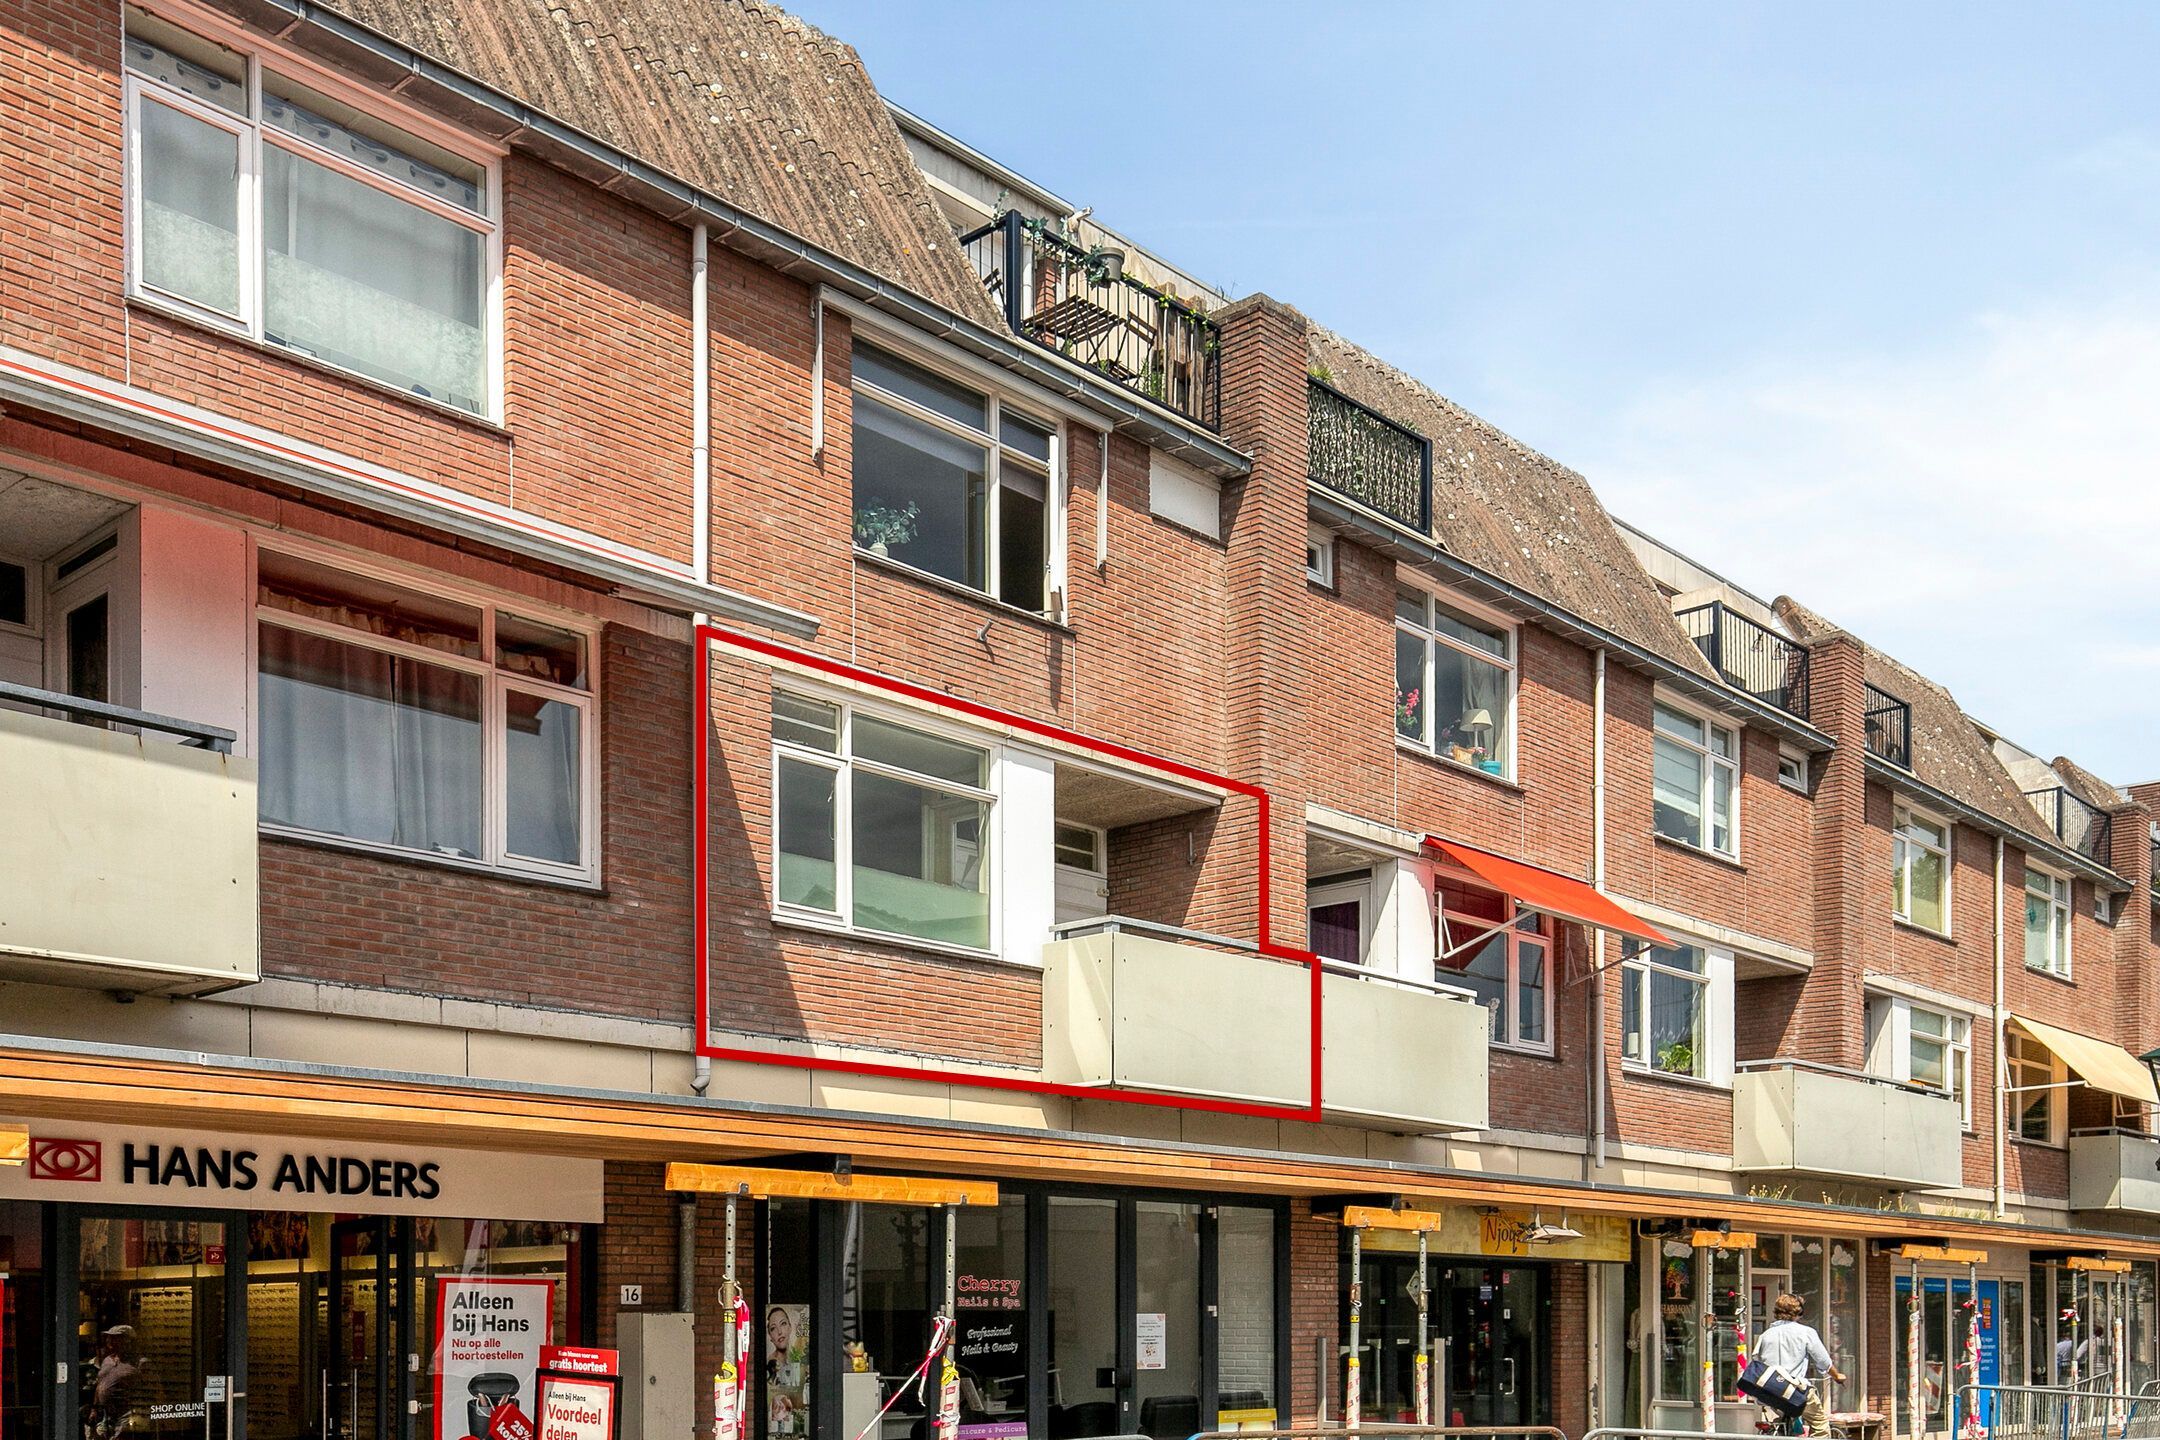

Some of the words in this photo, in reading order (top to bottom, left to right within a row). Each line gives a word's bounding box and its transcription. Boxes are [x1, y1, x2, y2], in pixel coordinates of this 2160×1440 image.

[123, 1143, 258, 1191] HANS
[272, 1154, 440, 1200] ANDERS
[957, 1274, 1021, 1297] Cherry
[452, 1291, 514, 1310] Alleen
[625, 1288, 639, 1301] 16
[957, 1296, 989, 1307] Nails
[1002, 1296, 1021, 1310] Spa
[452, 1313, 477, 1336] bij
[482, 1314, 530, 1332] Hans
[967, 1324, 1013, 1341] Professional
[452, 1338, 466, 1348] Nu
[469, 1340, 482, 1350] op
[484, 1338, 501, 1348] alle
[961, 1342, 983, 1356] Nails
[983, 1342, 990, 1354] &
[991, 1341, 1019, 1354] Beauty
[452, 1350, 524, 1361] hoortoestellen
[549, 1358, 572, 1369] gratis
[573, 1359, 608, 1373] hoortest
[548, 1391, 564, 1400] Alleen
[572, 1394, 586, 1402] Hans
[150, 1404, 173, 1413] SHOP
[175, 1402, 206, 1411] ONLINE
[150, 1410, 206, 1420] HANSANDERS.NL
[547, 1403, 602, 1425] Voordeel
[510, 1420, 532, 1440] 25%
[546, 1424, 578, 1440] delen
